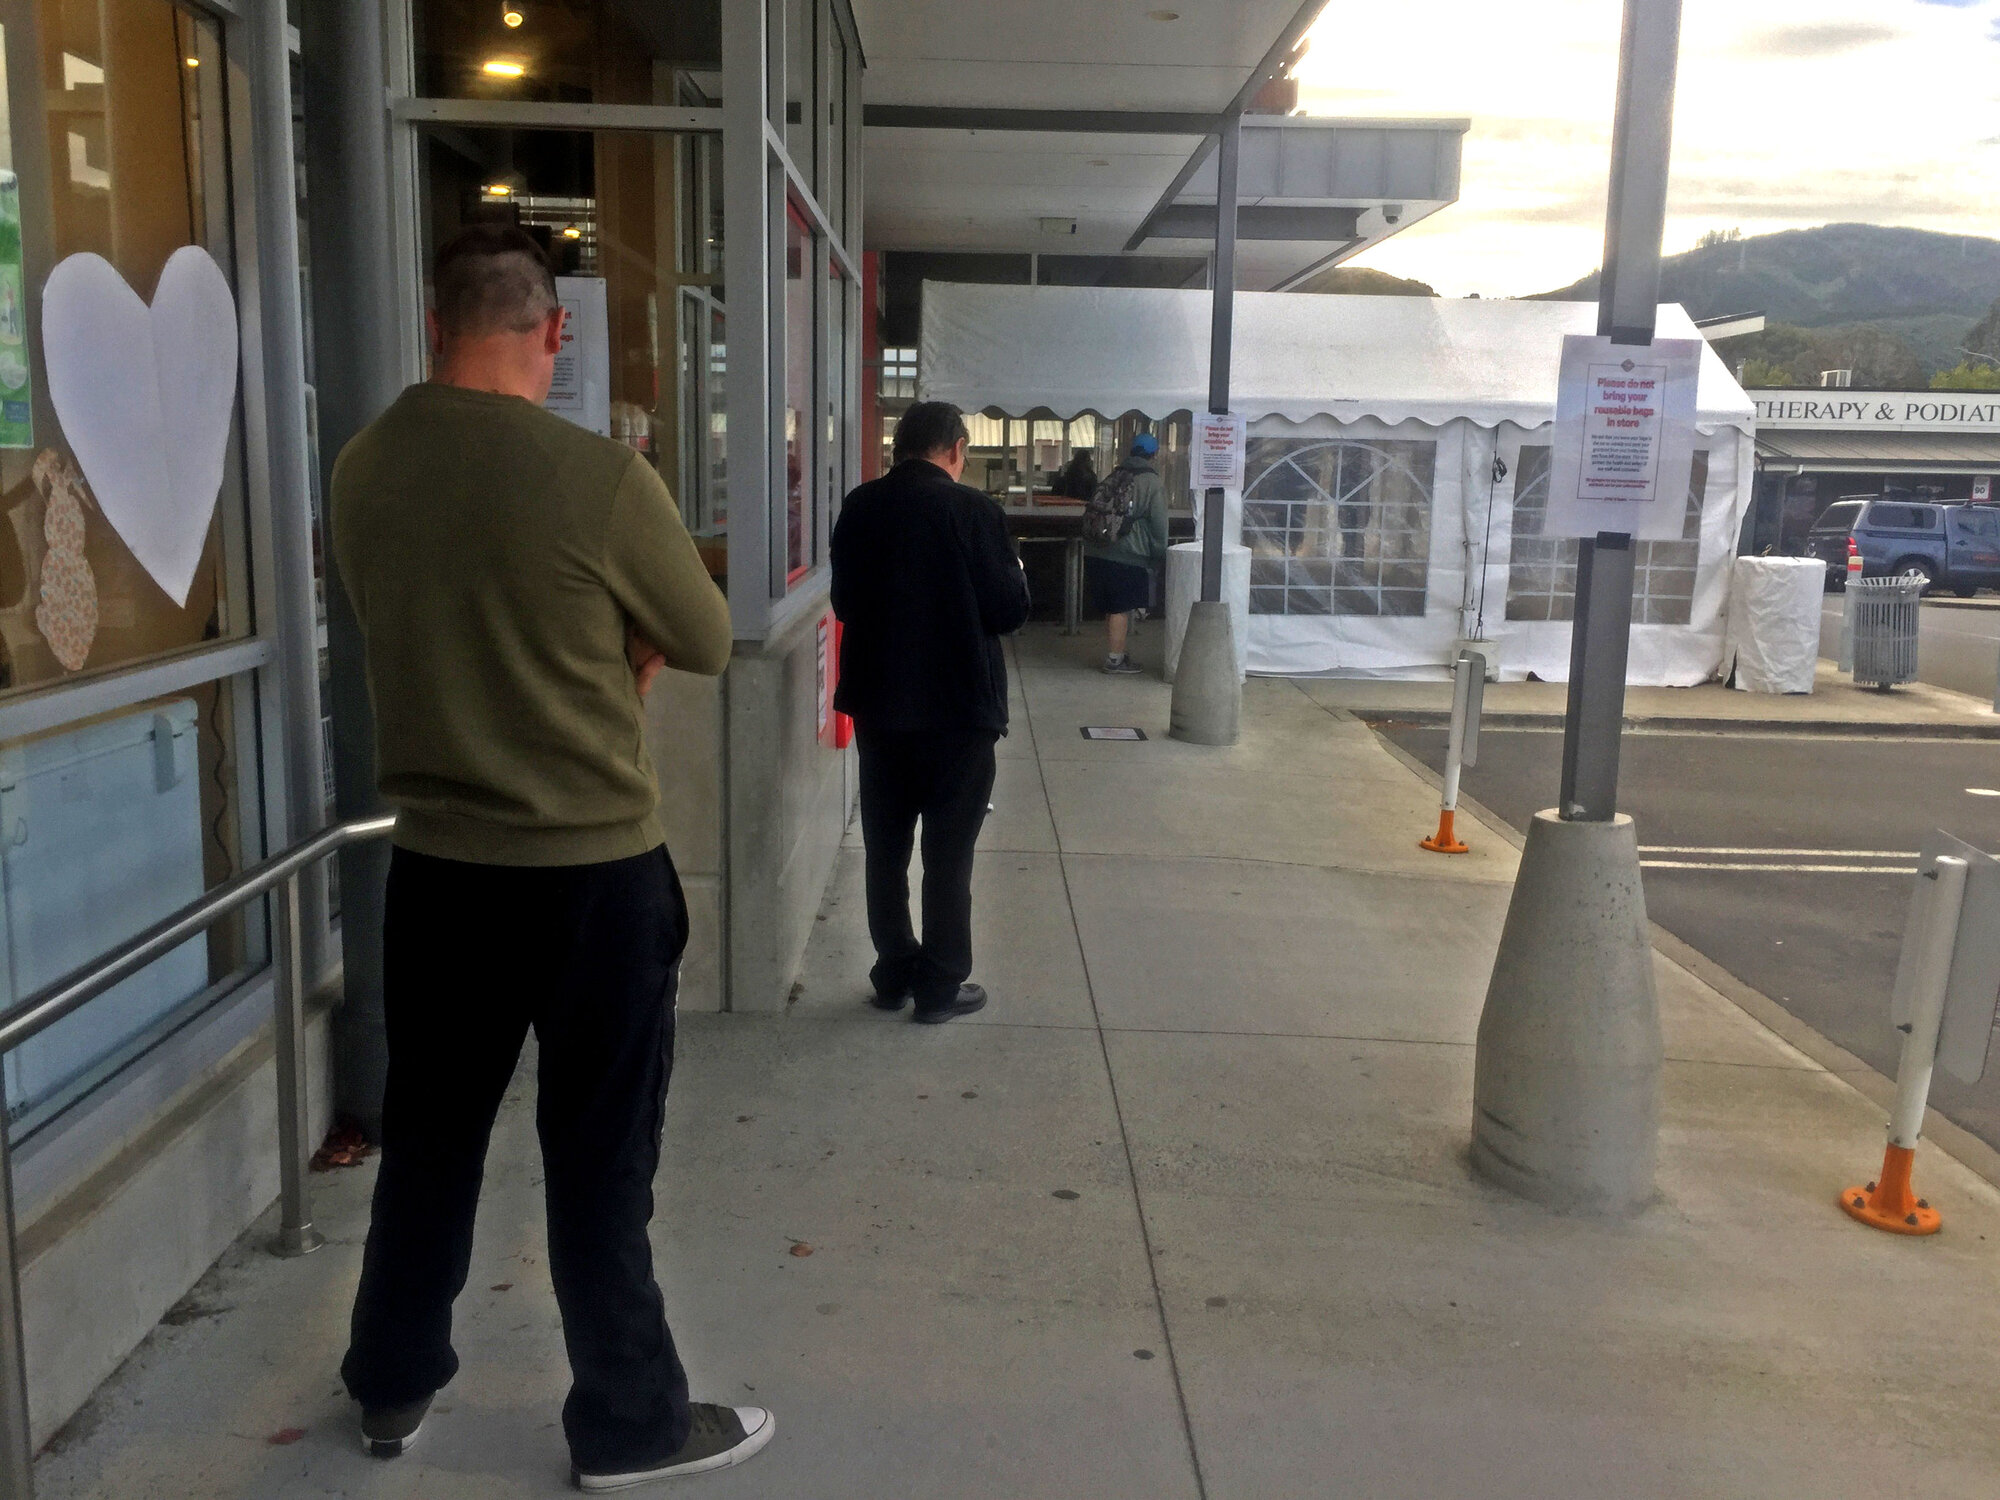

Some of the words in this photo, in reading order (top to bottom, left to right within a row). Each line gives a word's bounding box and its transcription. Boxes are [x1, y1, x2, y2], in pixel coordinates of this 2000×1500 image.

[1597, 377, 1625, 388] Please
[1627, 378, 1639, 389] do
[1640, 380, 1655, 389] not
[1603, 390, 1626, 402] bring
[1628, 393, 1648, 402] your
[1594, 405, 1631, 415] reusable
[1633, 406, 1654, 417] bags
[1755, 401, 1870, 420] THERAPY
[1875, 402, 1896, 421] &
[1904, 403, 2000, 422] PODIAT
[1607, 417, 1615, 427] in
[1617, 418, 1640, 428] store
[1974, 486, 1986, 494] 90
